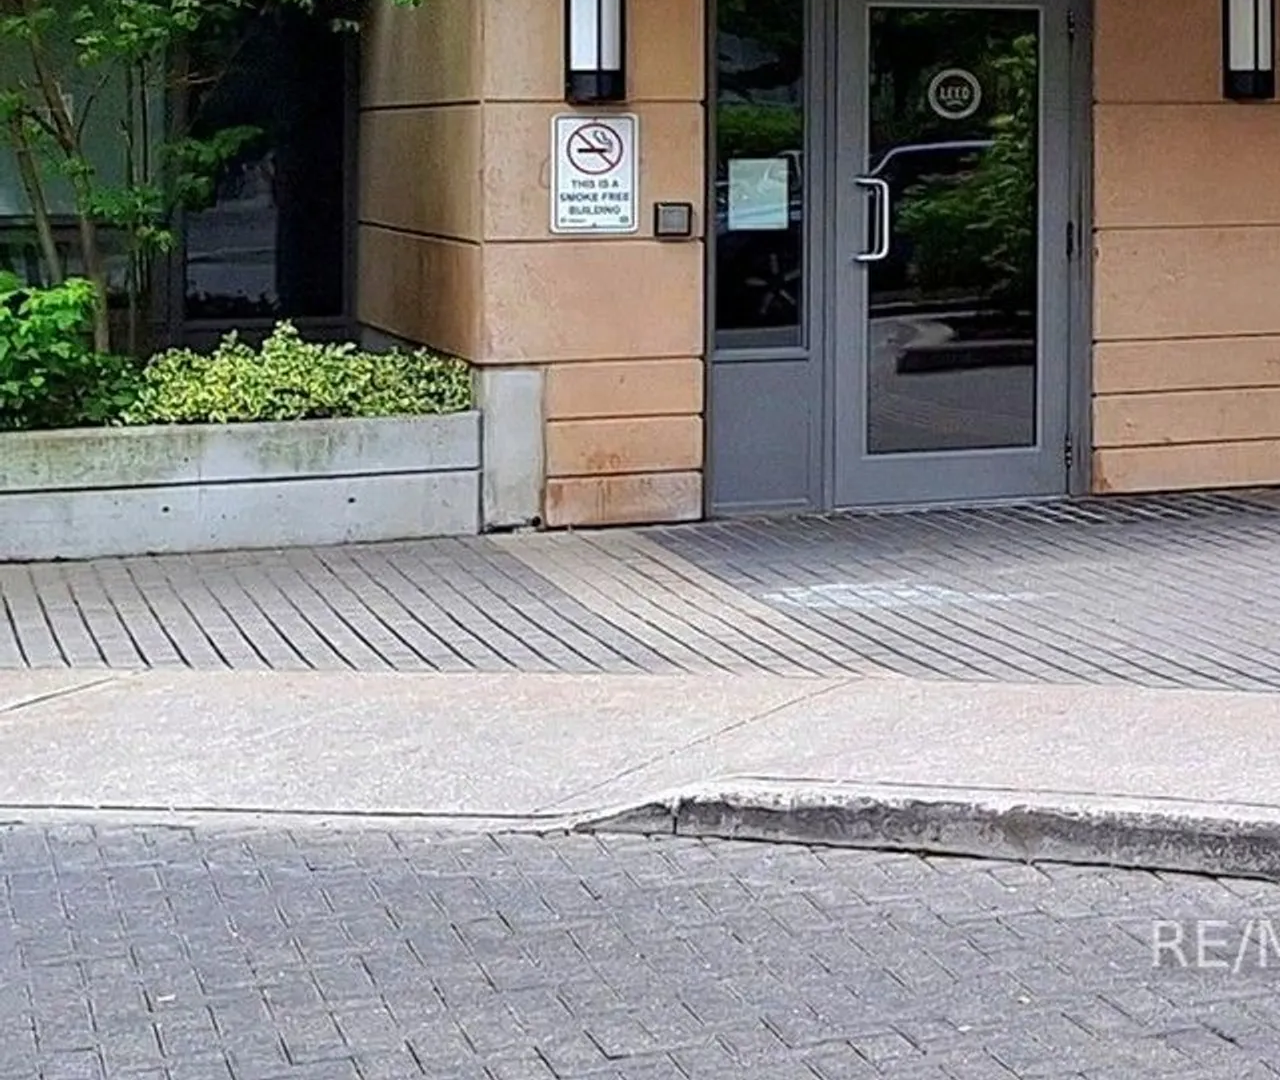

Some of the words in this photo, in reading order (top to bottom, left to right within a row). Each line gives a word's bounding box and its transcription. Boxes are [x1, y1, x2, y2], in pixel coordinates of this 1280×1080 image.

[571, 179, 595, 189] THIS
[598, 179, 609, 189] IS
[612, 179, 619, 188] A
[560, 192, 598, 202] SMOKE
[601, 192, 629, 202] FREE
[568, 205, 621, 216] BUILDING
